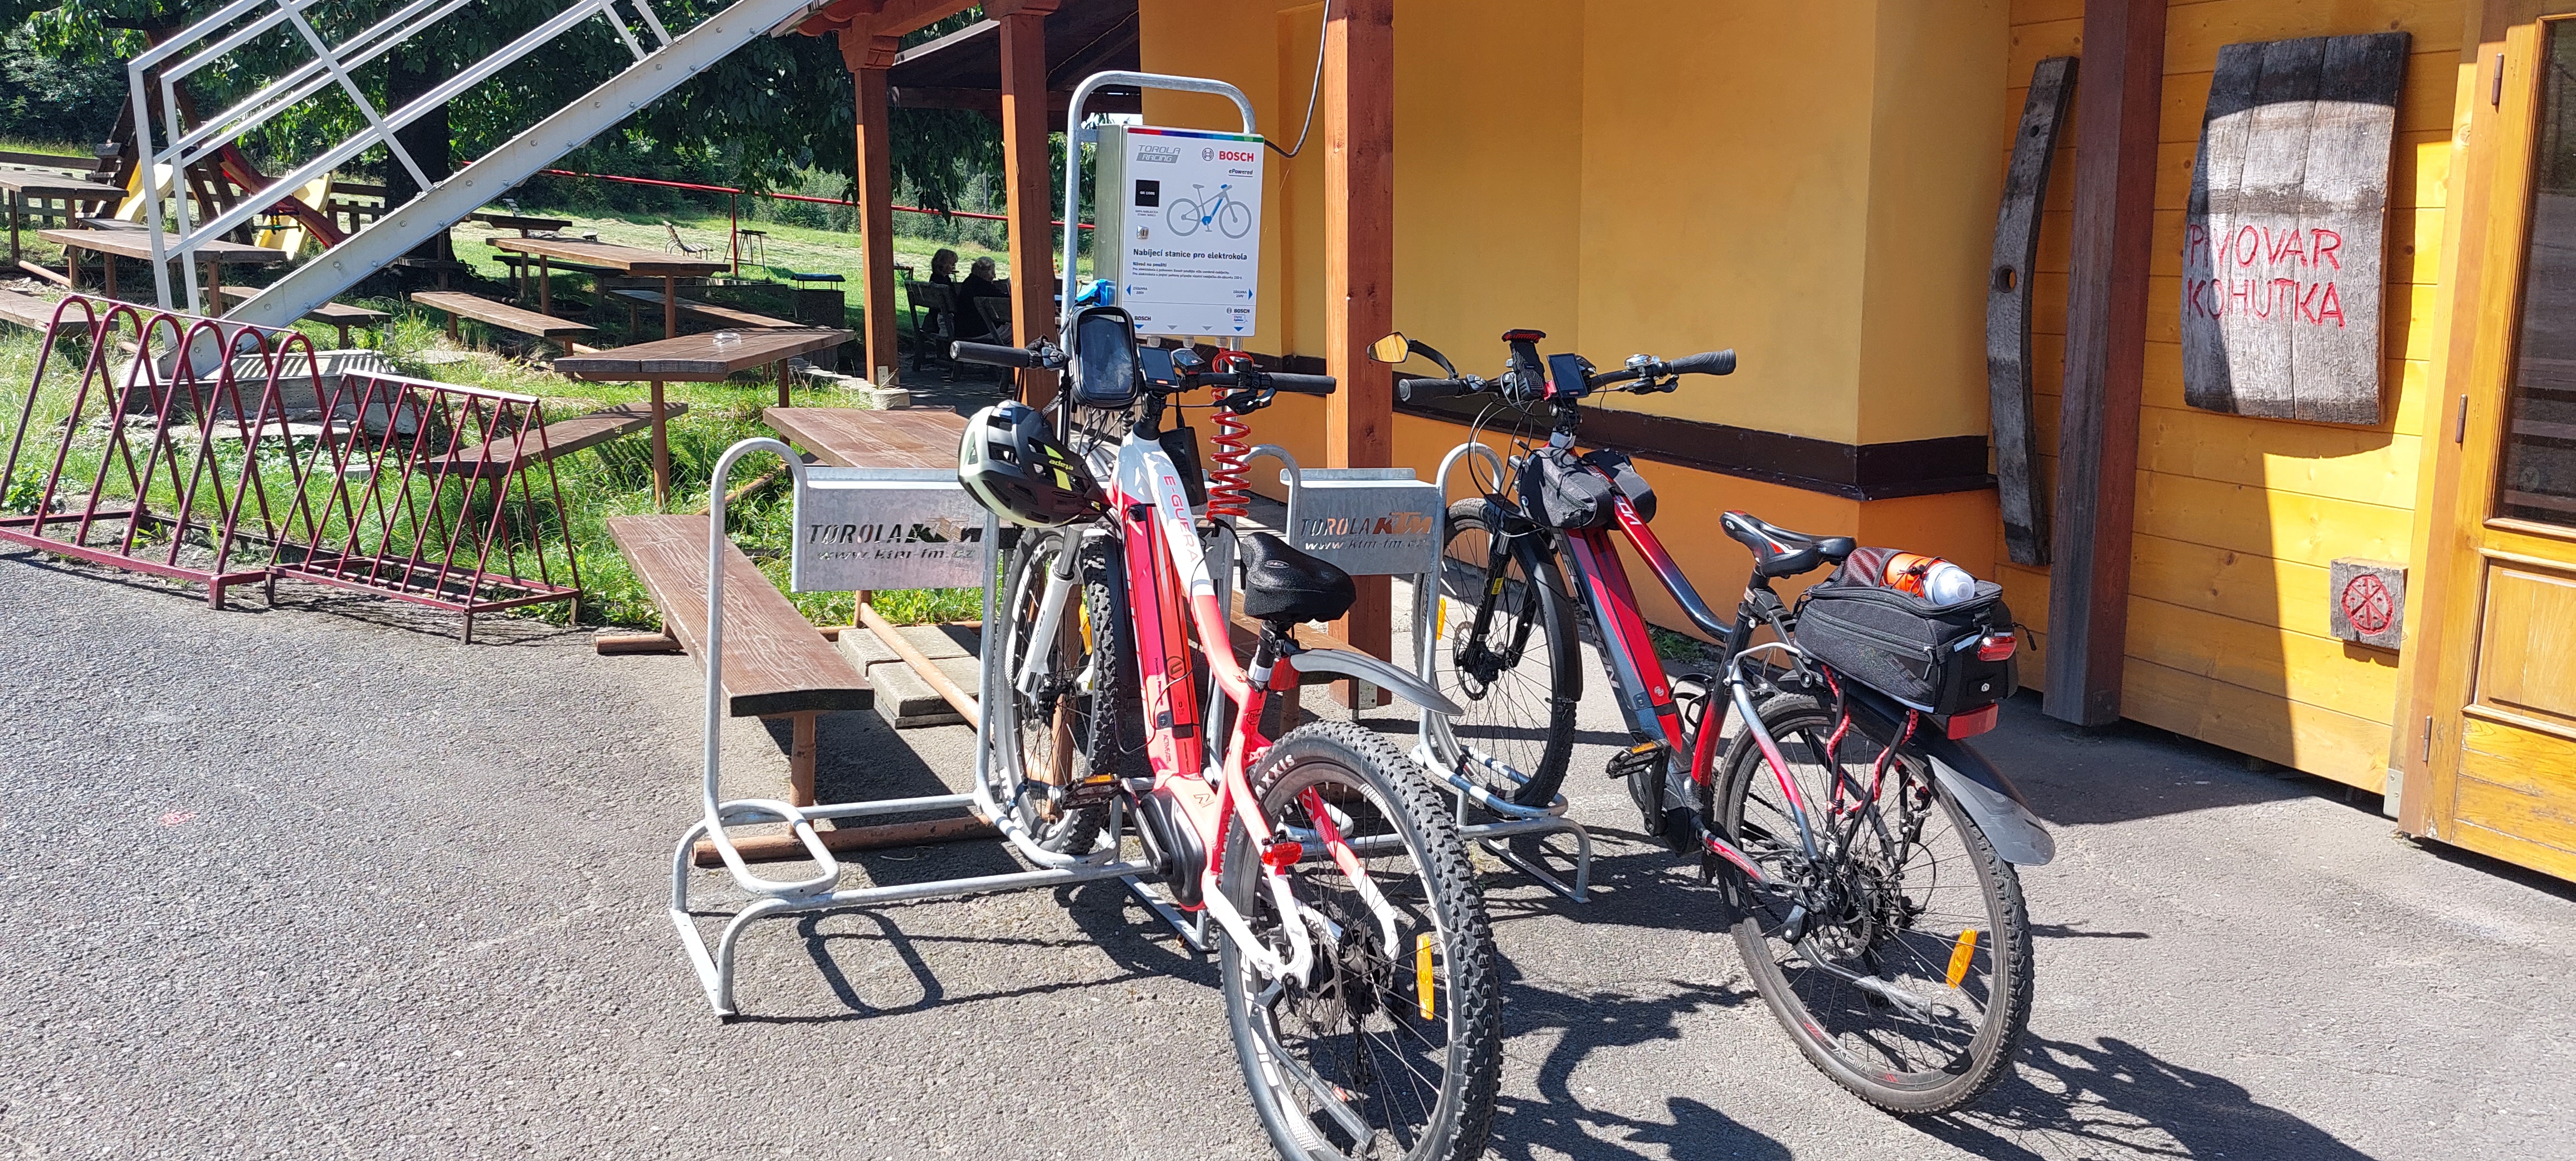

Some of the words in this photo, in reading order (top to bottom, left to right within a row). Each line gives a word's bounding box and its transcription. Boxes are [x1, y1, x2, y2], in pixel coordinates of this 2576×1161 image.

[1138, 144, 1181, 154] TOROLA
[1141, 154, 1173, 162] RACING
[1219, 150, 1254, 162] BOSCH
[2188, 224, 2342, 271] PIVOVAR
[2187, 277, 2345, 329] KOHUTKA
[1048, 459, 1074, 471] etape
[809, 523, 902, 544] TOROLA
[905, 517, 985, 543] KTM
[1163, 476, 1198, 562] E-GUERA
[1300, 518, 1370, 536] TOROLA
[1372, 512, 1433, 535] KTM
[1255, 754, 1295, 801] AXXIS
